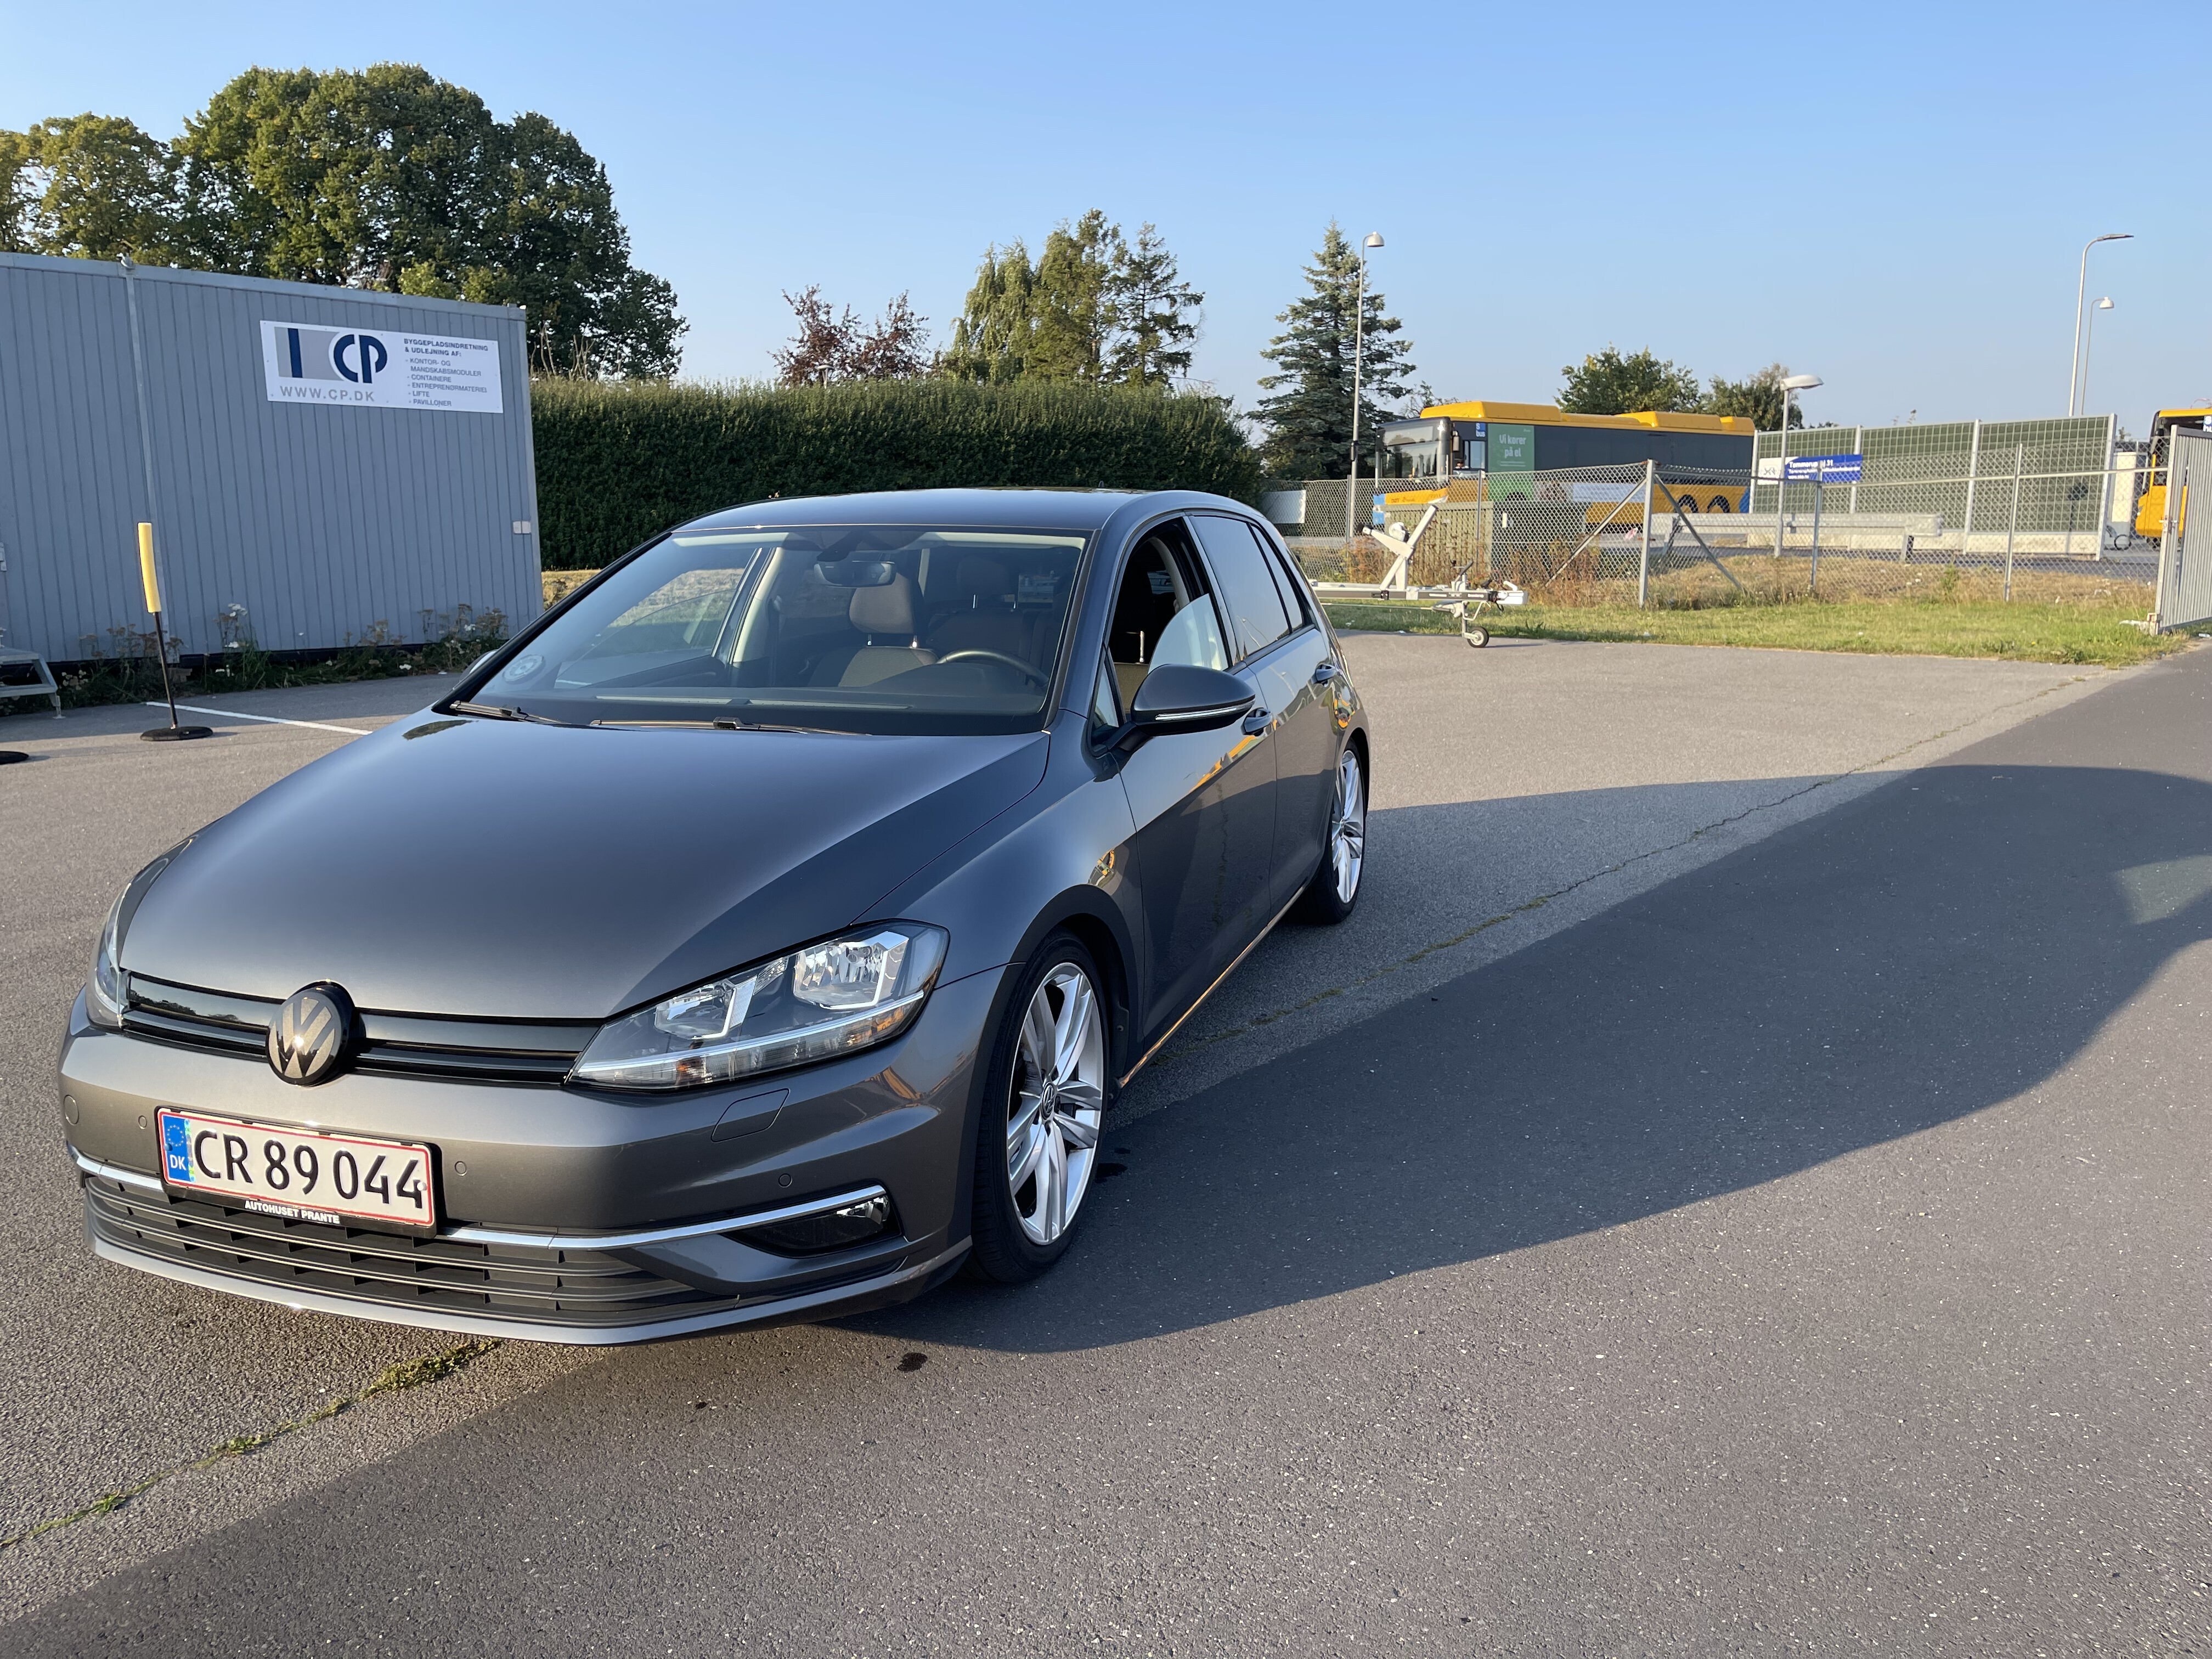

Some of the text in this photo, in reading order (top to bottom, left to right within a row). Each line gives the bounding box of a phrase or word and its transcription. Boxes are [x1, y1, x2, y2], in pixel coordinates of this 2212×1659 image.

[404, 338, 488, 351] BYGGEPLADSINDRETNING
[411, 347, 449, 356] UDLEJNING
[333, 334, 388, 384] CP
[410, 365, 482, 376] MANDSKABSMODULER
[411, 374, 452, 382] CONTAINERE
[280, 386, 375, 402] WWW.CP.DK
[413, 398, 452, 407] PAVILLONER
[1499, 435, 1506, 444] Vi
[1505, 447, 1521, 458] på el
[170, 1154, 187, 1171] DK
[194, 1130, 423, 1209] CR 89 044
[245, 1200, 340, 1224] AUTOHUSET PRANTE
